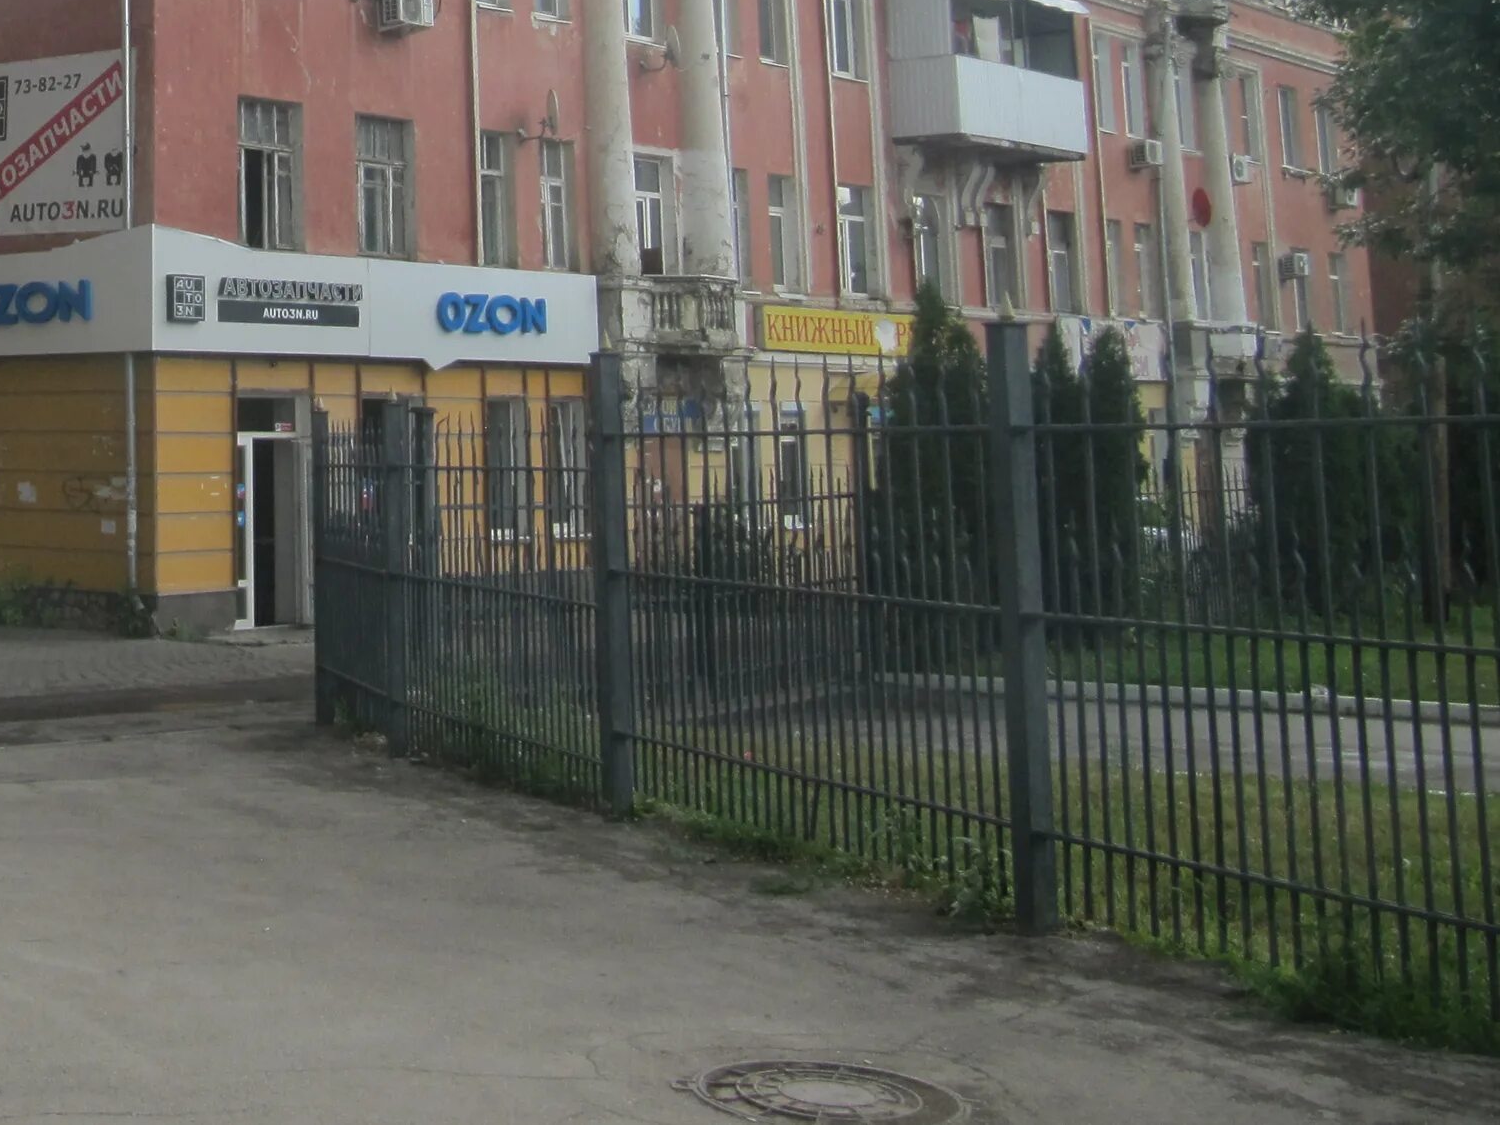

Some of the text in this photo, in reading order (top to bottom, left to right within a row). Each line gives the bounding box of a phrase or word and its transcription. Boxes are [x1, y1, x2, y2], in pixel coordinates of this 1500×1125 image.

[13, 73, 82, 95] 73-82-27
[9, 198, 124, 223] AUTO3N.RU
[219, 277, 364, 302] АВТОЗАПЧАСТИ
[262, 307, 319, 320] AUTO3N.RU
[437, 291, 547, 334] OZON
[766, 313, 875, 347] КНИЖНЫЙ
